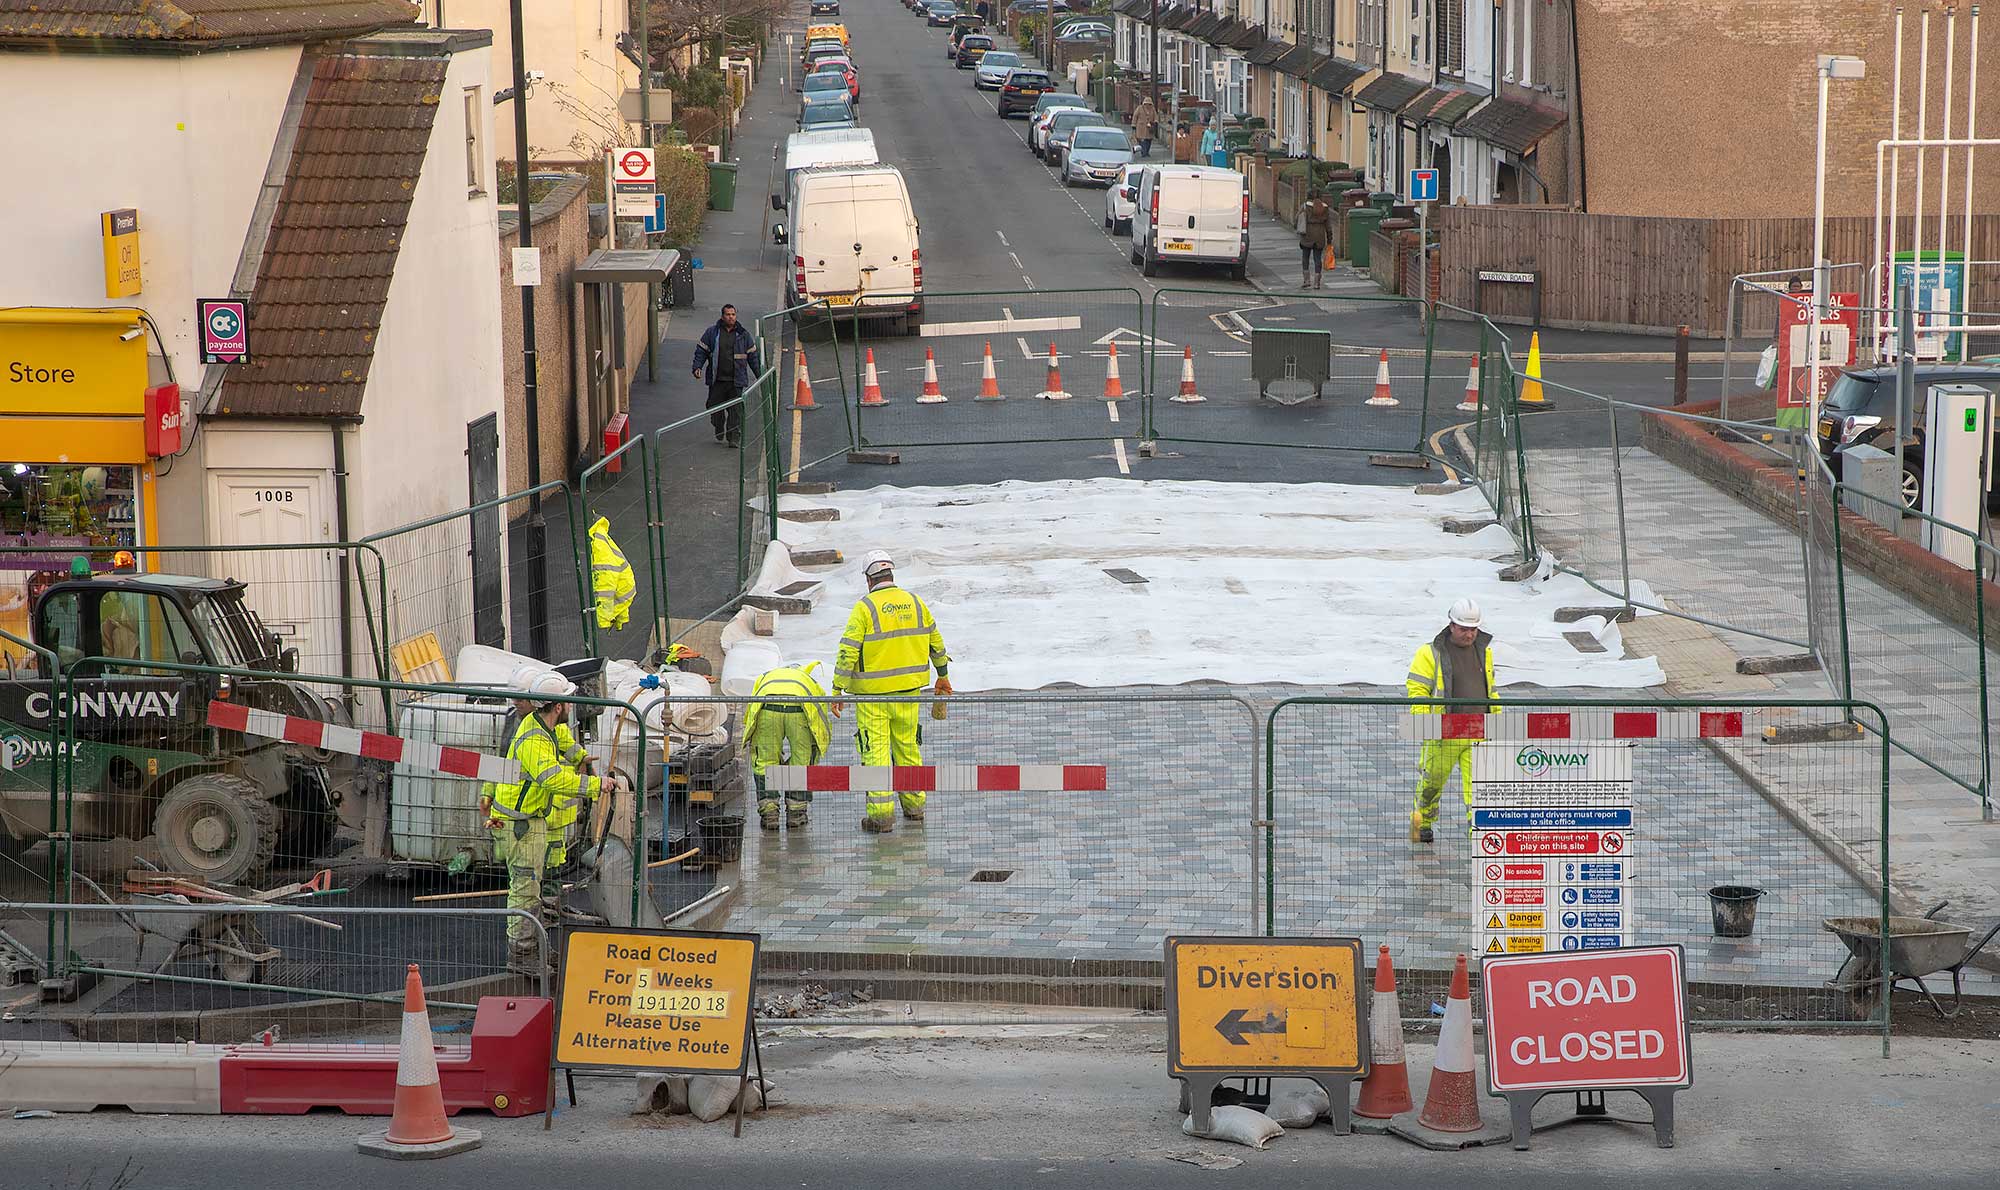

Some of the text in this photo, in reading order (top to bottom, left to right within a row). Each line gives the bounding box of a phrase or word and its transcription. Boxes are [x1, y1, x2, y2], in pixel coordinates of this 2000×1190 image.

[116, 216, 134, 230] Premier
[122, 245, 132, 264] Off
[118, 266, 139, 284] Licence
[1480, 272, 1527, 282] OVERTON ROAD
[1796, 296, 1844, 308] SPAL
[208, 342, 243, 350] payzone
[9, 362, 75, 383] Store
[160, 411, 180, 431] Sun
[255, 490, 293, 502] 100B
[25, 691, 180, 718] CONWAY
[1516, 753, 1589, 766] CONWAY
[1594, 812, 1618, 820] report
[1516, 834, 1589, 842] Children must not
[1520, 843, 1539, 852] play
[1516, 868, 1542, 876] smoking
[1509, 914, 1541, 923] Danger
[606, 944, 717, 964] Road Closed
[604, 969, 713, 988] For 5 Weeks
[1198, 966, 1337, 990] Diversion
[588, 990, 631, 1006] From
[1528, 974, 1637, 1009] ROAD
[605, 1013, 701, 1032] Please Use
[572, 1032, 730, 1055] Alternative Route
[1510, 1029, 1665, 1066] CLOSED
